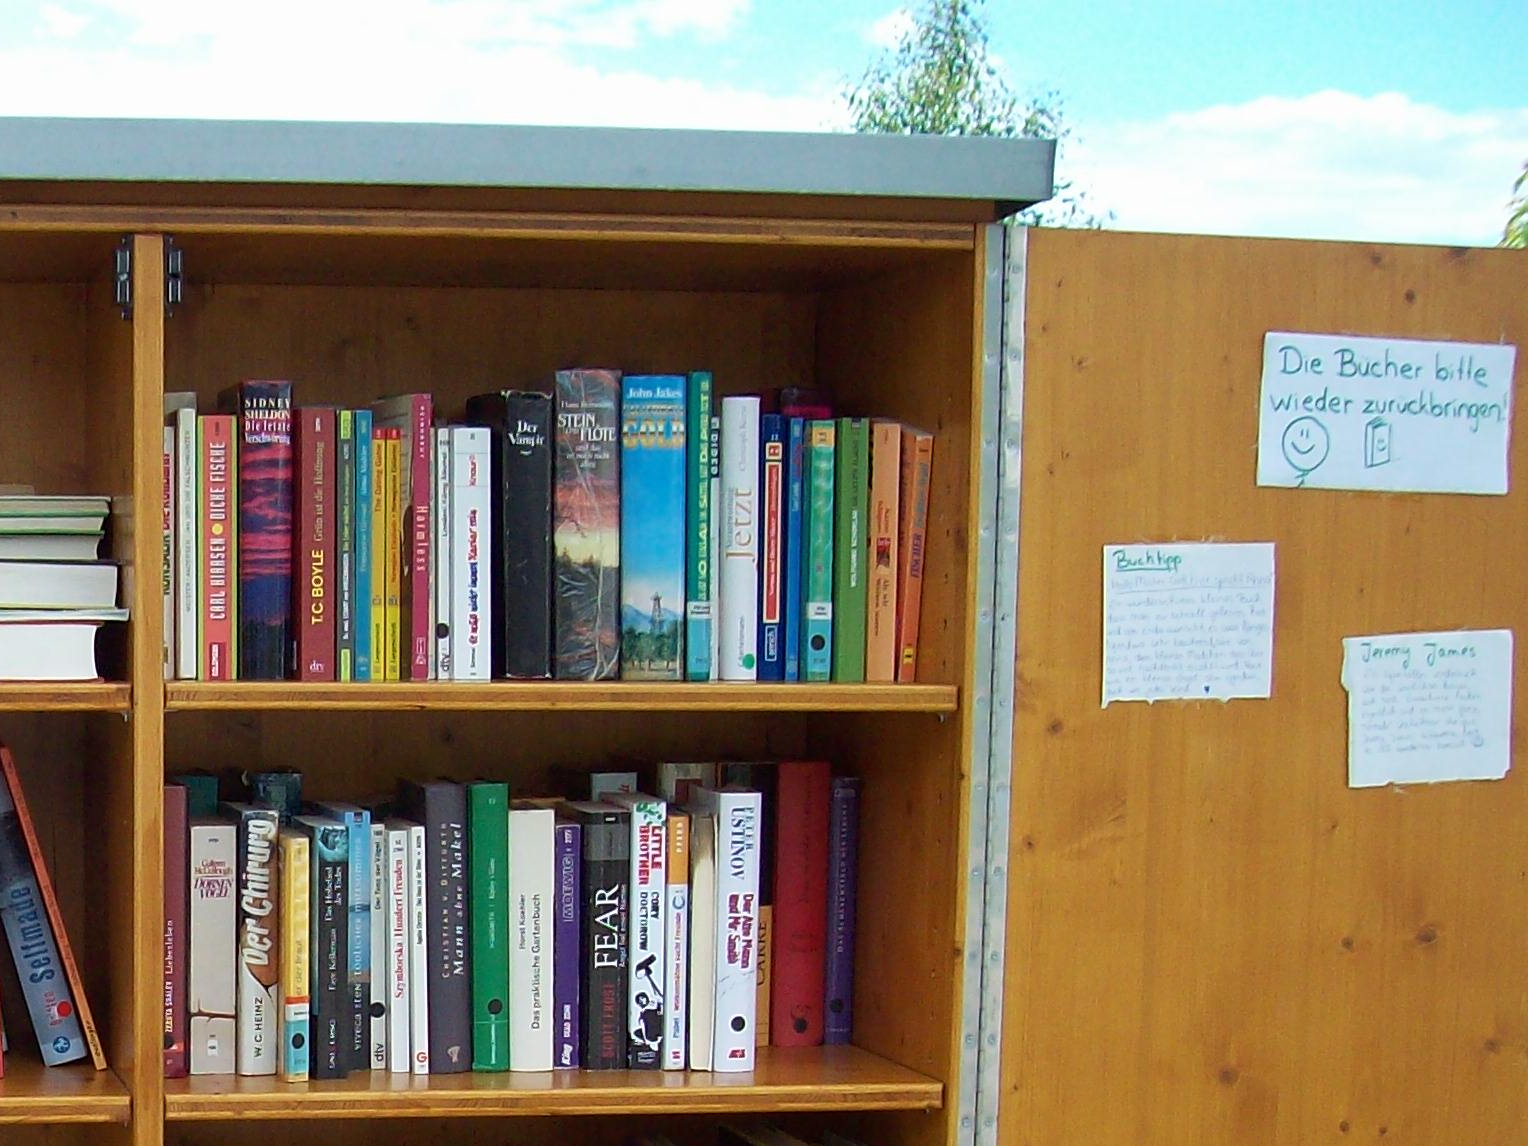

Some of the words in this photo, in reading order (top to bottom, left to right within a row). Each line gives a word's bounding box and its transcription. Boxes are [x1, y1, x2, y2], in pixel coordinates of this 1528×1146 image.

[1279, 346, 1323, 374] Die
[1436, 352, 1488, 387] bitte
[244, 398, 291, 408] SIDNEY
[627, 388, 653, 399] John
[656, 388, 683, 398] Jakes
[1270, 387, 1353, 414] wieder
[244, 409, 291, 420] SHELDON
[244, 421, 261, 431] Die
[517, 419, 540, 434] Der
[558, 413, 595, 427] STEIN
[209, 441, 225, 482] FISCHE
[415, 505, 428, 572] Harmless
[311, 549, 324, 597] BOYLE
[209, 590, 226, 620] CARL
[1423, 643, 1477, 666] James
[451, 822, 463, 878] Makel
[637, 825, 650, 885] BROTHER
[650, 824, 662, 870] LITTLE
[729, 807, 746, 881] USTINOV
[241, 819, 273, 916] Chirurg
[531, 893, 541, 953] Gartenbuch
[650, 891, 660, 919] CORY
[241, 918, 272, 966] Der
[594, 884, 621, 968] FEAR
[394, 942, 407, 999] Szymborska
[453, 925, 465, 975] Mann
[532, 955, 542, 1009] praktische
[253, 996, 264, 1031] HEINZ
[532, 1010, 541, 1029] Das
[374, 1043, 384, 1062] dtv
